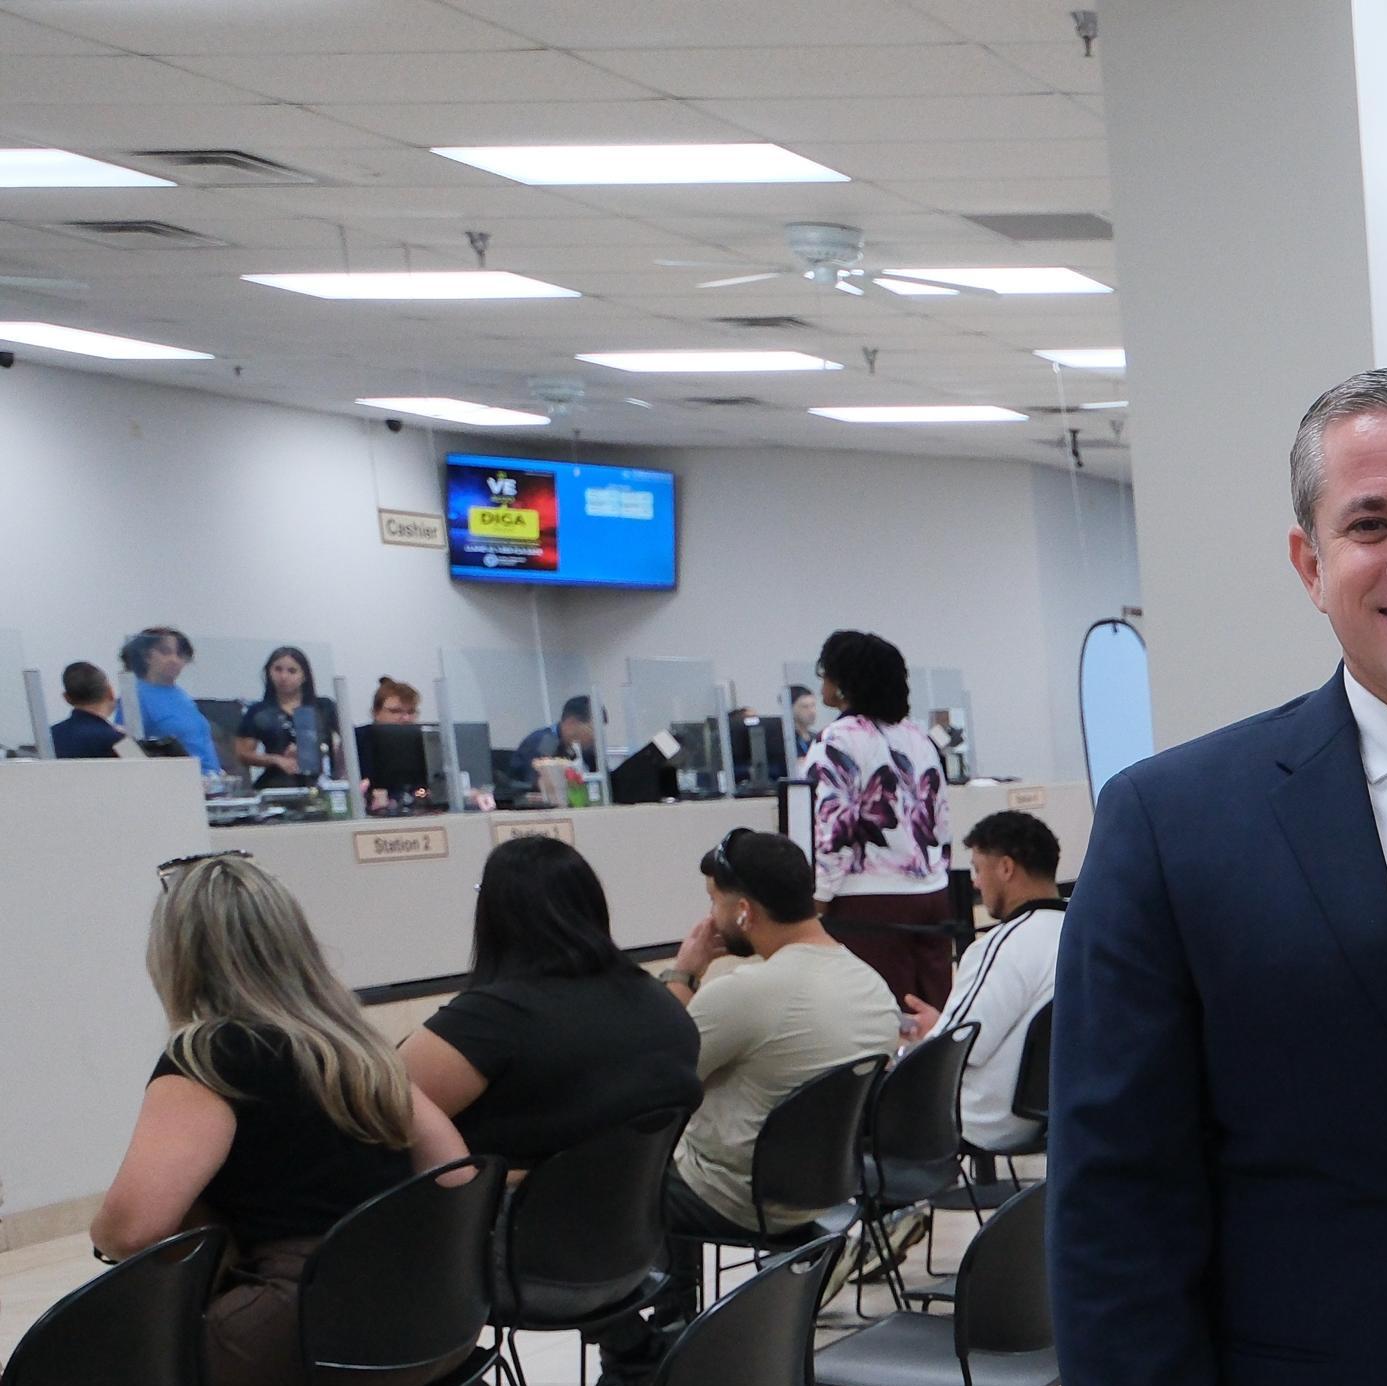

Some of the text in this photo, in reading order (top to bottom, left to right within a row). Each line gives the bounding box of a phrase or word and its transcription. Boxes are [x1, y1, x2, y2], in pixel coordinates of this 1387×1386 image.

[486, 477, 517, 496] VE
[374, 834, 431, 855] Station 2
